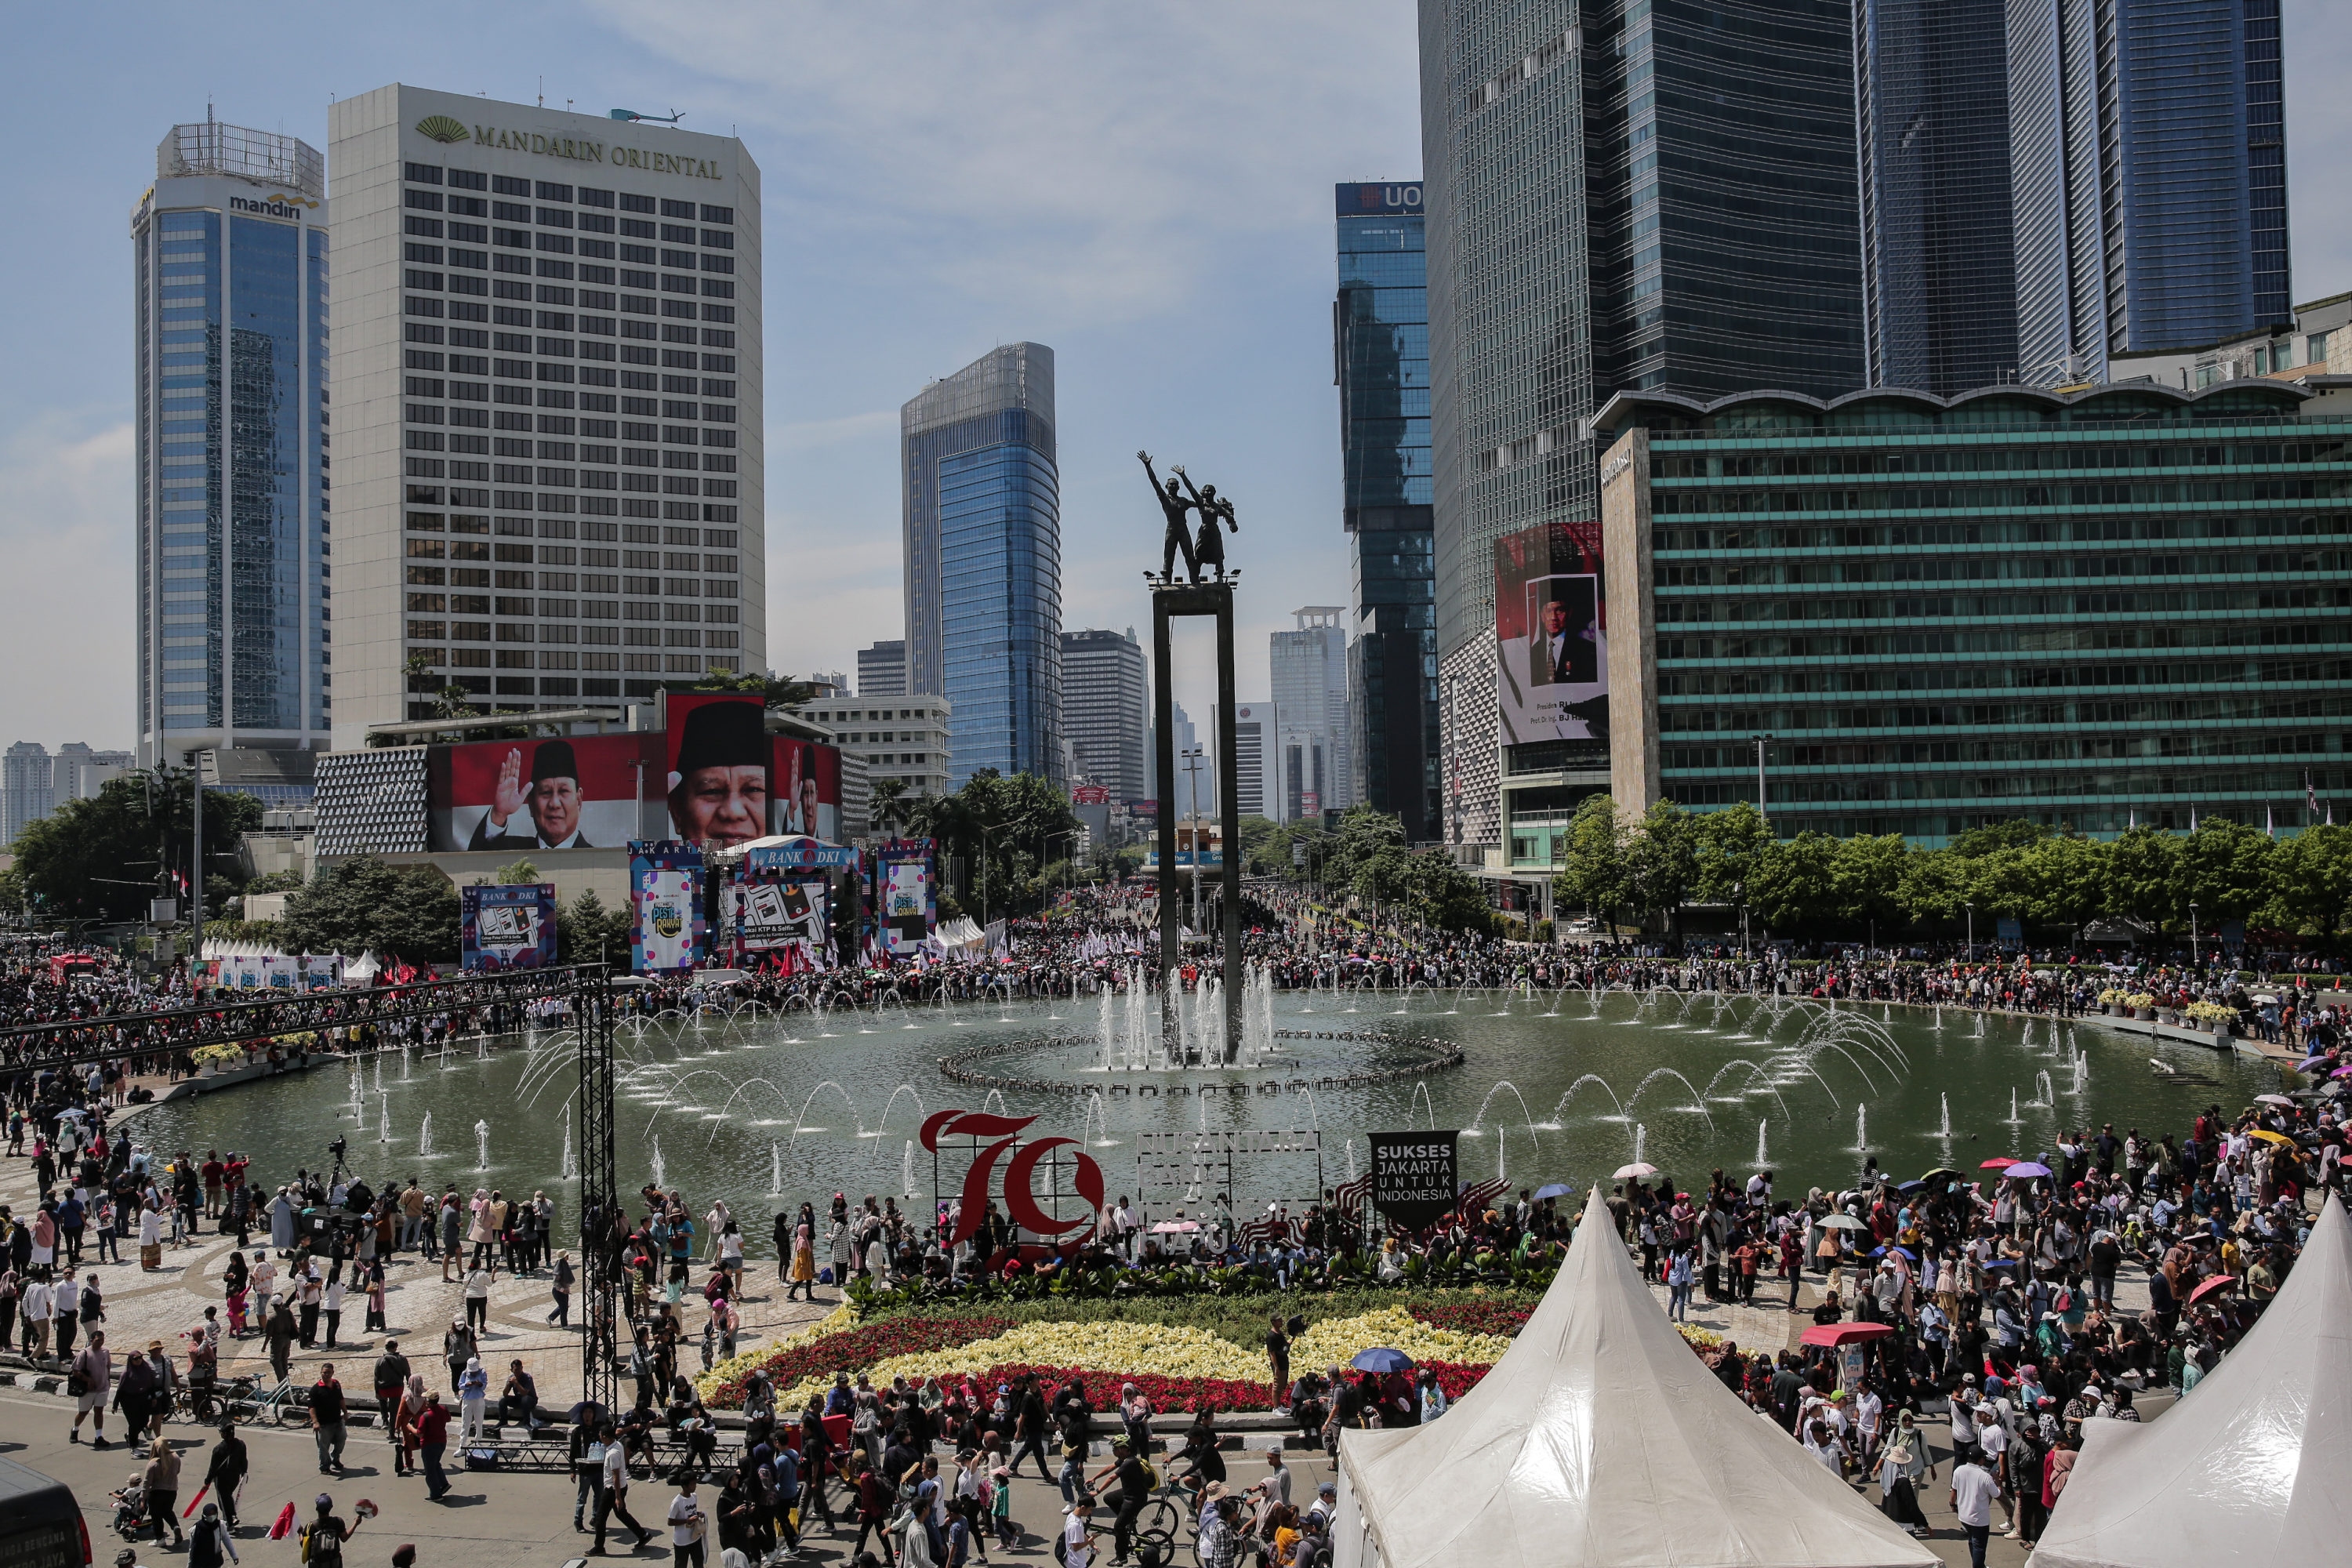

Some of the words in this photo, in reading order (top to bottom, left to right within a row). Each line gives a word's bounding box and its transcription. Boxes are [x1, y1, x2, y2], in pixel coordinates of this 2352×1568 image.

[474, 125, 604, 163] MANDARIN
[612, 146, 723, 180] ORIENTAL
[230, 196, 300, 220] mandiri
[1537, 702, 1557, 711] Presiden
[628, 846, 702, 855] JAKARTA
[768, 851, 802, 863] BANK
[817, 851, 840, 862] DKI
[481, 892, 506, 902] BANK
[518, 891, 535, 900] DKI
[895, 898, 913, 910] PESTA
[652, 908, 676, 923] PESTA
[656, 918, 684, 933] RAKYAT
[241, 975, 256, 989] PESTA
[272, 975, 290, 988] PESTA
[1137, 1129, 1322, 1157] NUSANTARA
[1377, 1145, 1451, 1160] SUKSES
[1138, 1162, 1220, 1188] BARU
[1378, 1160, 1450, 1175] JAKARTA
[1380, 1175, 1450, 1188] UNTUK
[1378, 1189, 1452, 1202] INDONESIA
[1138, 1197, 1306, 1226] INDONESIA
[1138, 1225, 1229, 1256] MAJU
[24, 1530, 66, 1552] BENCANA
